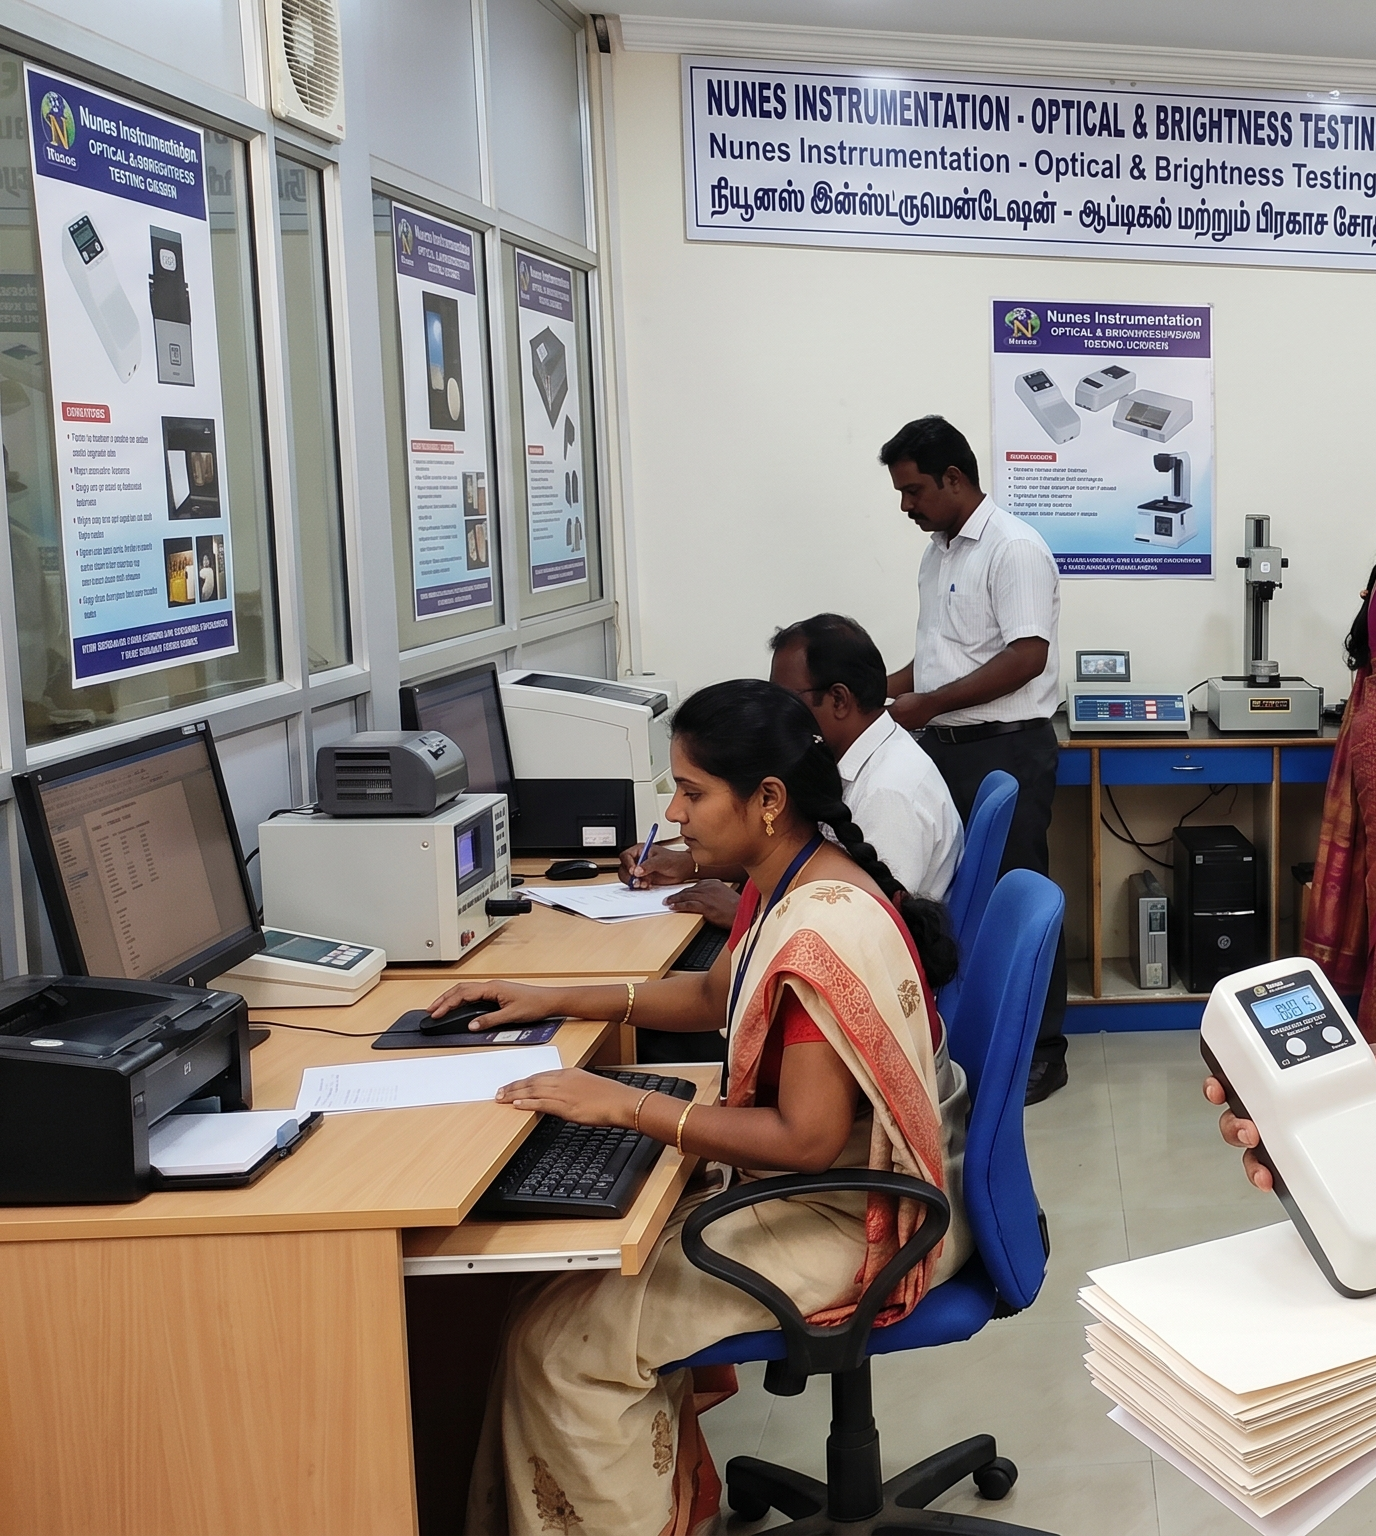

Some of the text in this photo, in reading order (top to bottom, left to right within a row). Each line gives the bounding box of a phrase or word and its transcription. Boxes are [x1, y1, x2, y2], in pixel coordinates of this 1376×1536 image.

[79, 105, 117, 137] Nunes
[707, 78, 787, 120] NUNES
[794, 83, 1011, 132] INSTRUMENTATION
[1031, 97, 1125, 138] OPTICAL
[1132, 103, 1148, 139] &
[1155, 105, 1292, 147] BRIGHTNESS
[89, 139, 129, 165] OPTICAL
[709, 132, 791, 162] Nunes
[1034, 149, 1121, 182] Optical
[1129, 154, 1146, 180] &
[1155, 155, 1284, 190] Brightness
[1293, 163, 1376, 197] Testing
[109, 166, 145, 190] TESTING
[1178, 197, 1250, 242] மற்றும்
[1256, 200, 1329, 240] பிரகாச
[1047, 310, 1202, 327] Nunes Instrumentation
[1051, 327, 1093, 337] OPTICAL
